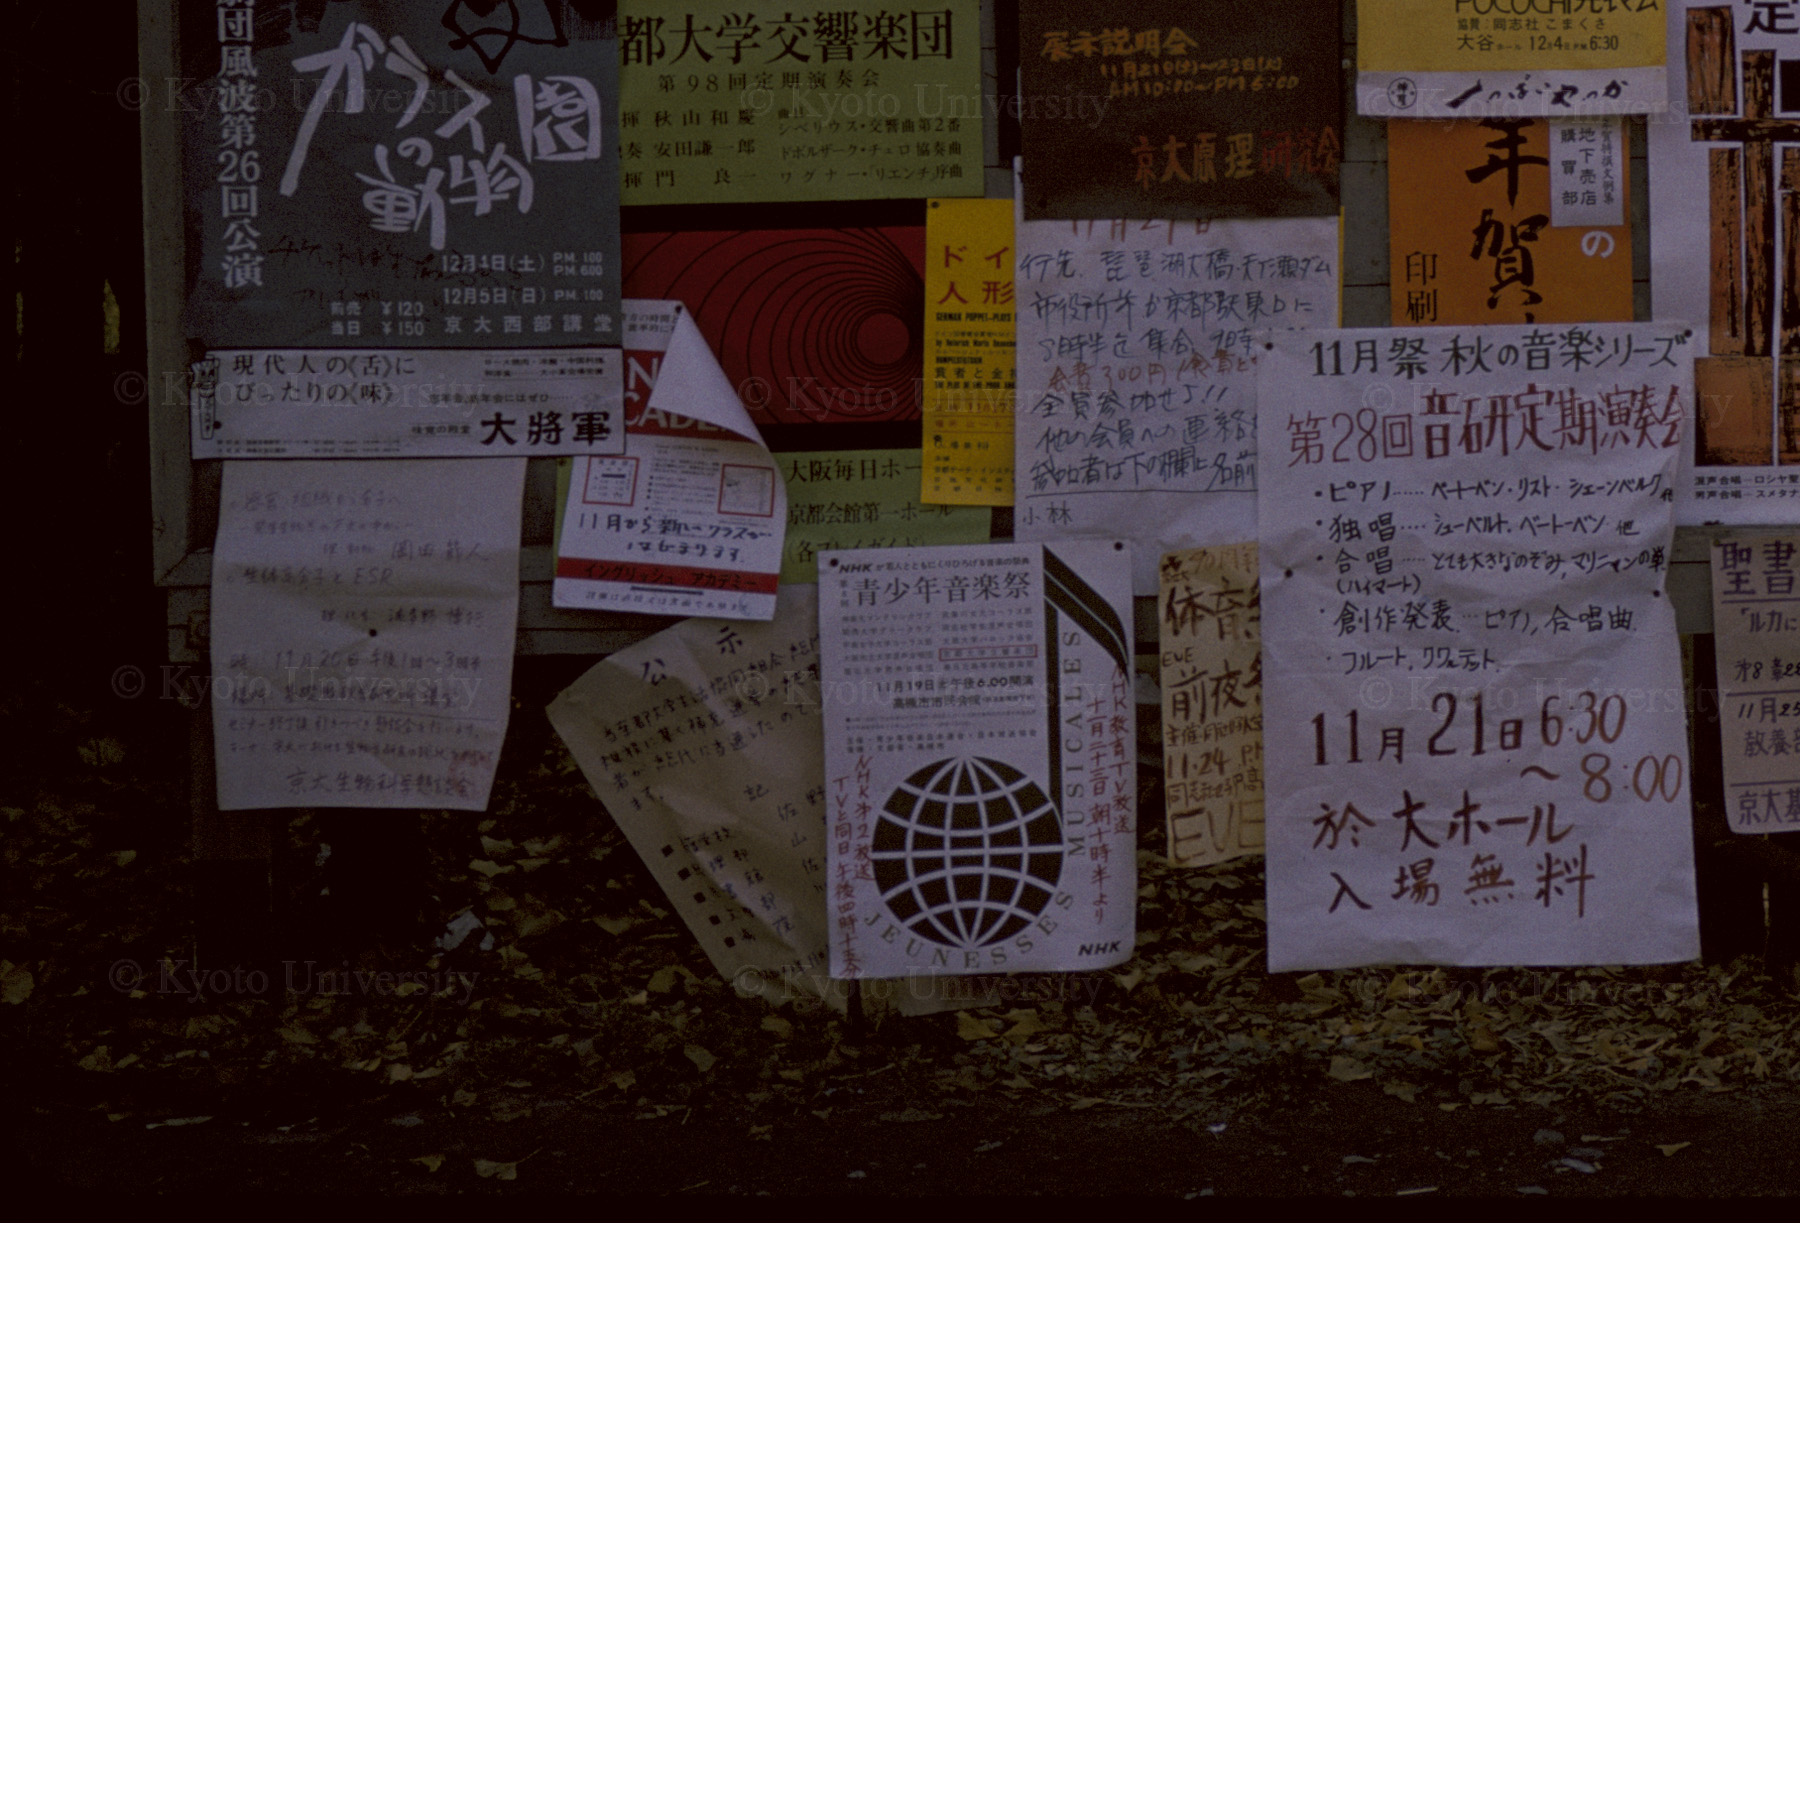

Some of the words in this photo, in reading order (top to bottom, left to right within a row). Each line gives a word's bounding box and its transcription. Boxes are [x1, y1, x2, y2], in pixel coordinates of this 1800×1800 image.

[659, 69, 880, 91] 第98回定期演奏会
[1581, 230, 1615, 258] の
[1406, 251, 1438, 323] 印刷
[444, 315, 612, 334] 京大西部講堂
[1310, 336, 1428, 380] 11月祭
[1286, 409, 1414, 467] 第28回
[1328, 512, 1396, 543] 独唱
[839, 563, 872, 574] NHK
[1334, 546, 1394, 576] 合唱
[854, 571, 1030, 607] 青少年音楽祭
[1540, 690, 1627, 747] 6:30
[1392, 790, 1574, 851] 大ホール
[1328, 843, 1595, 918] 入場無料
[1078, 940, 1120, 957] NHK
